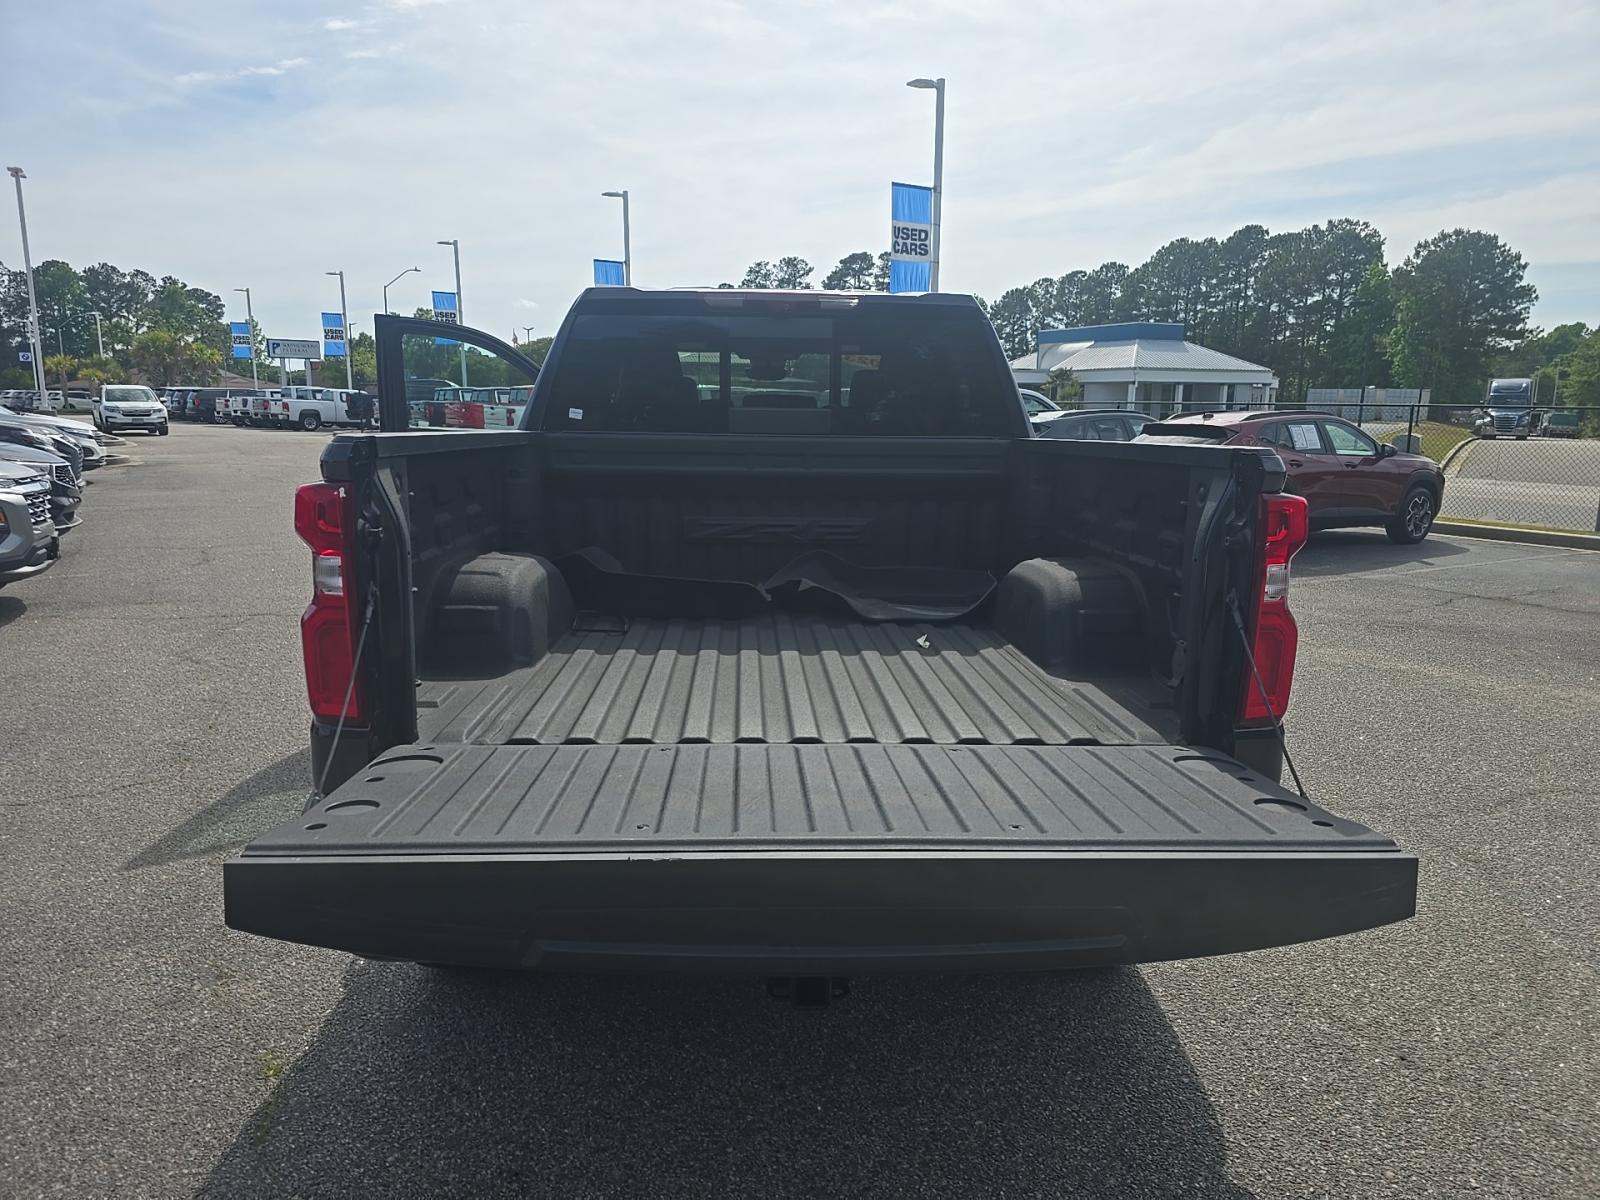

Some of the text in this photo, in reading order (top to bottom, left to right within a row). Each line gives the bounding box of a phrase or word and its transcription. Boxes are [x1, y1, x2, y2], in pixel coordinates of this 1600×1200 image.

[893, 226, 929, 242] USED
[893, 240, 929, 256] CARS
[434, 311, 457, 319] USED
